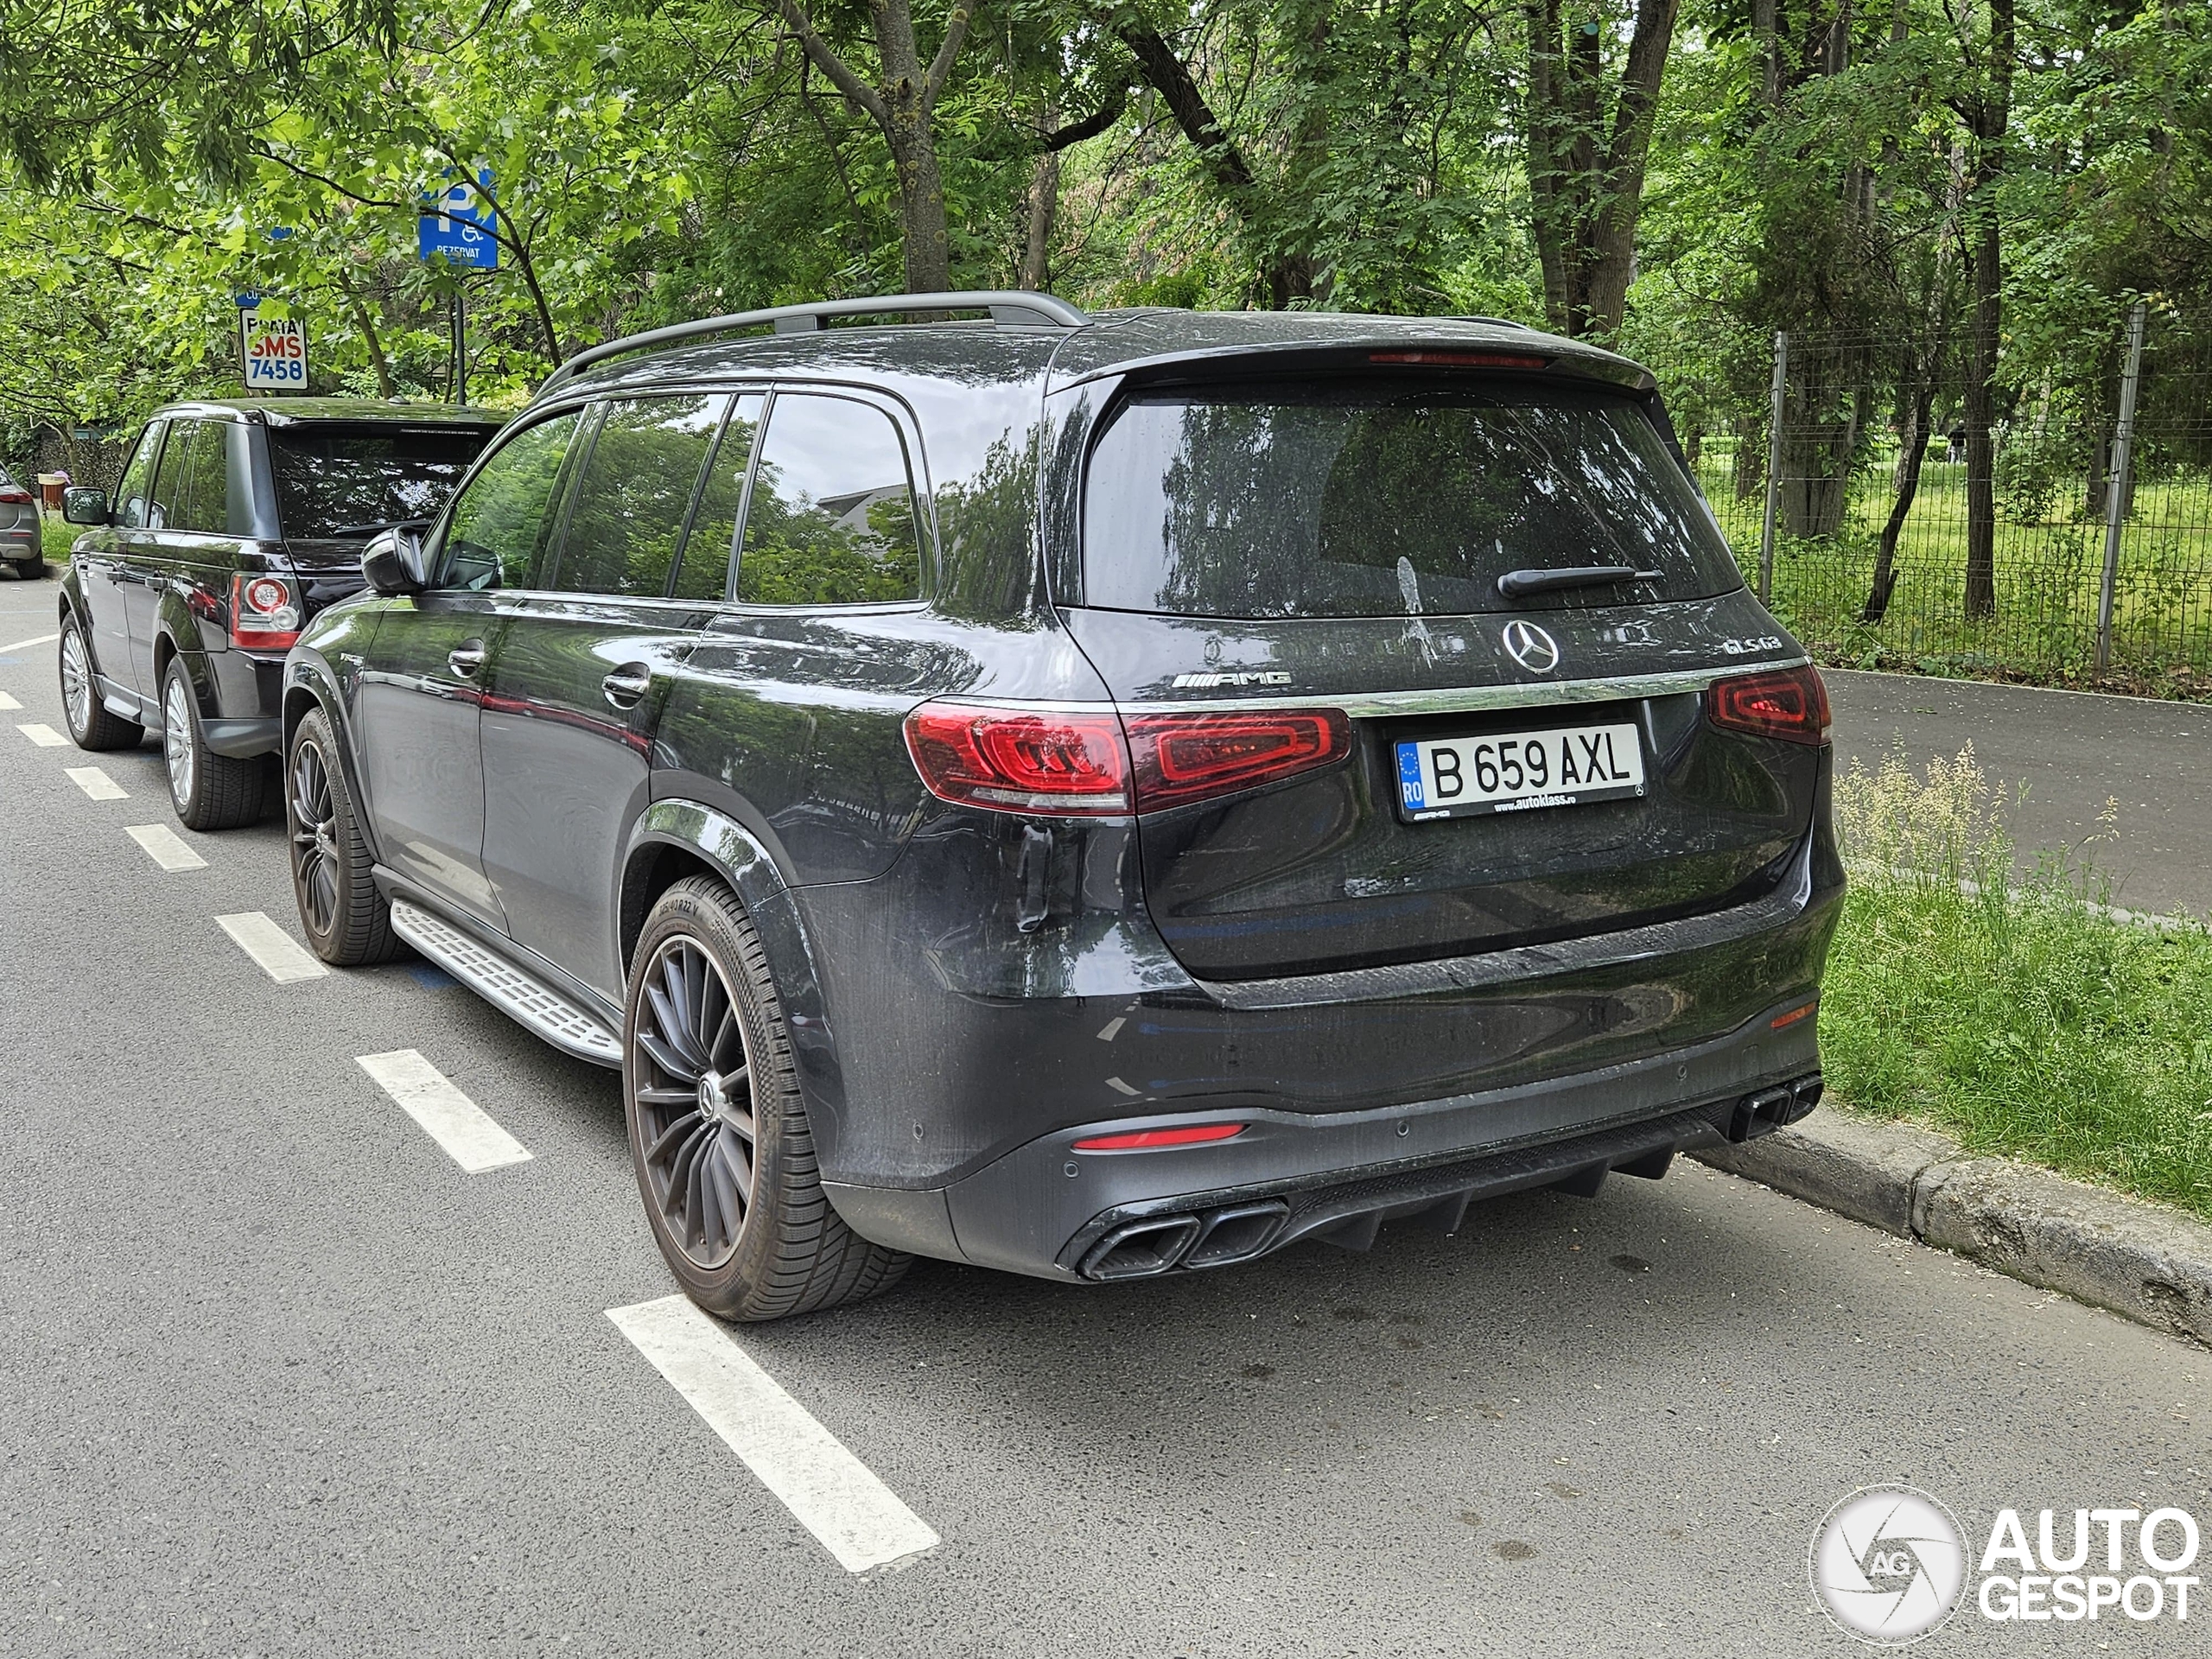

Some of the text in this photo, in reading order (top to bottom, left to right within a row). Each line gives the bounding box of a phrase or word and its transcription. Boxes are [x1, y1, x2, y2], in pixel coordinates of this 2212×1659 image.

[250, 359, 302, 380] 7458
[1202, 671, 1293, 687] AMG
[1431, 733, 1630, 799] B 659 AXL
[1402, 781, 1423, 803] RO
[1494, 794, 1576, 813] www.autoklass.ro
